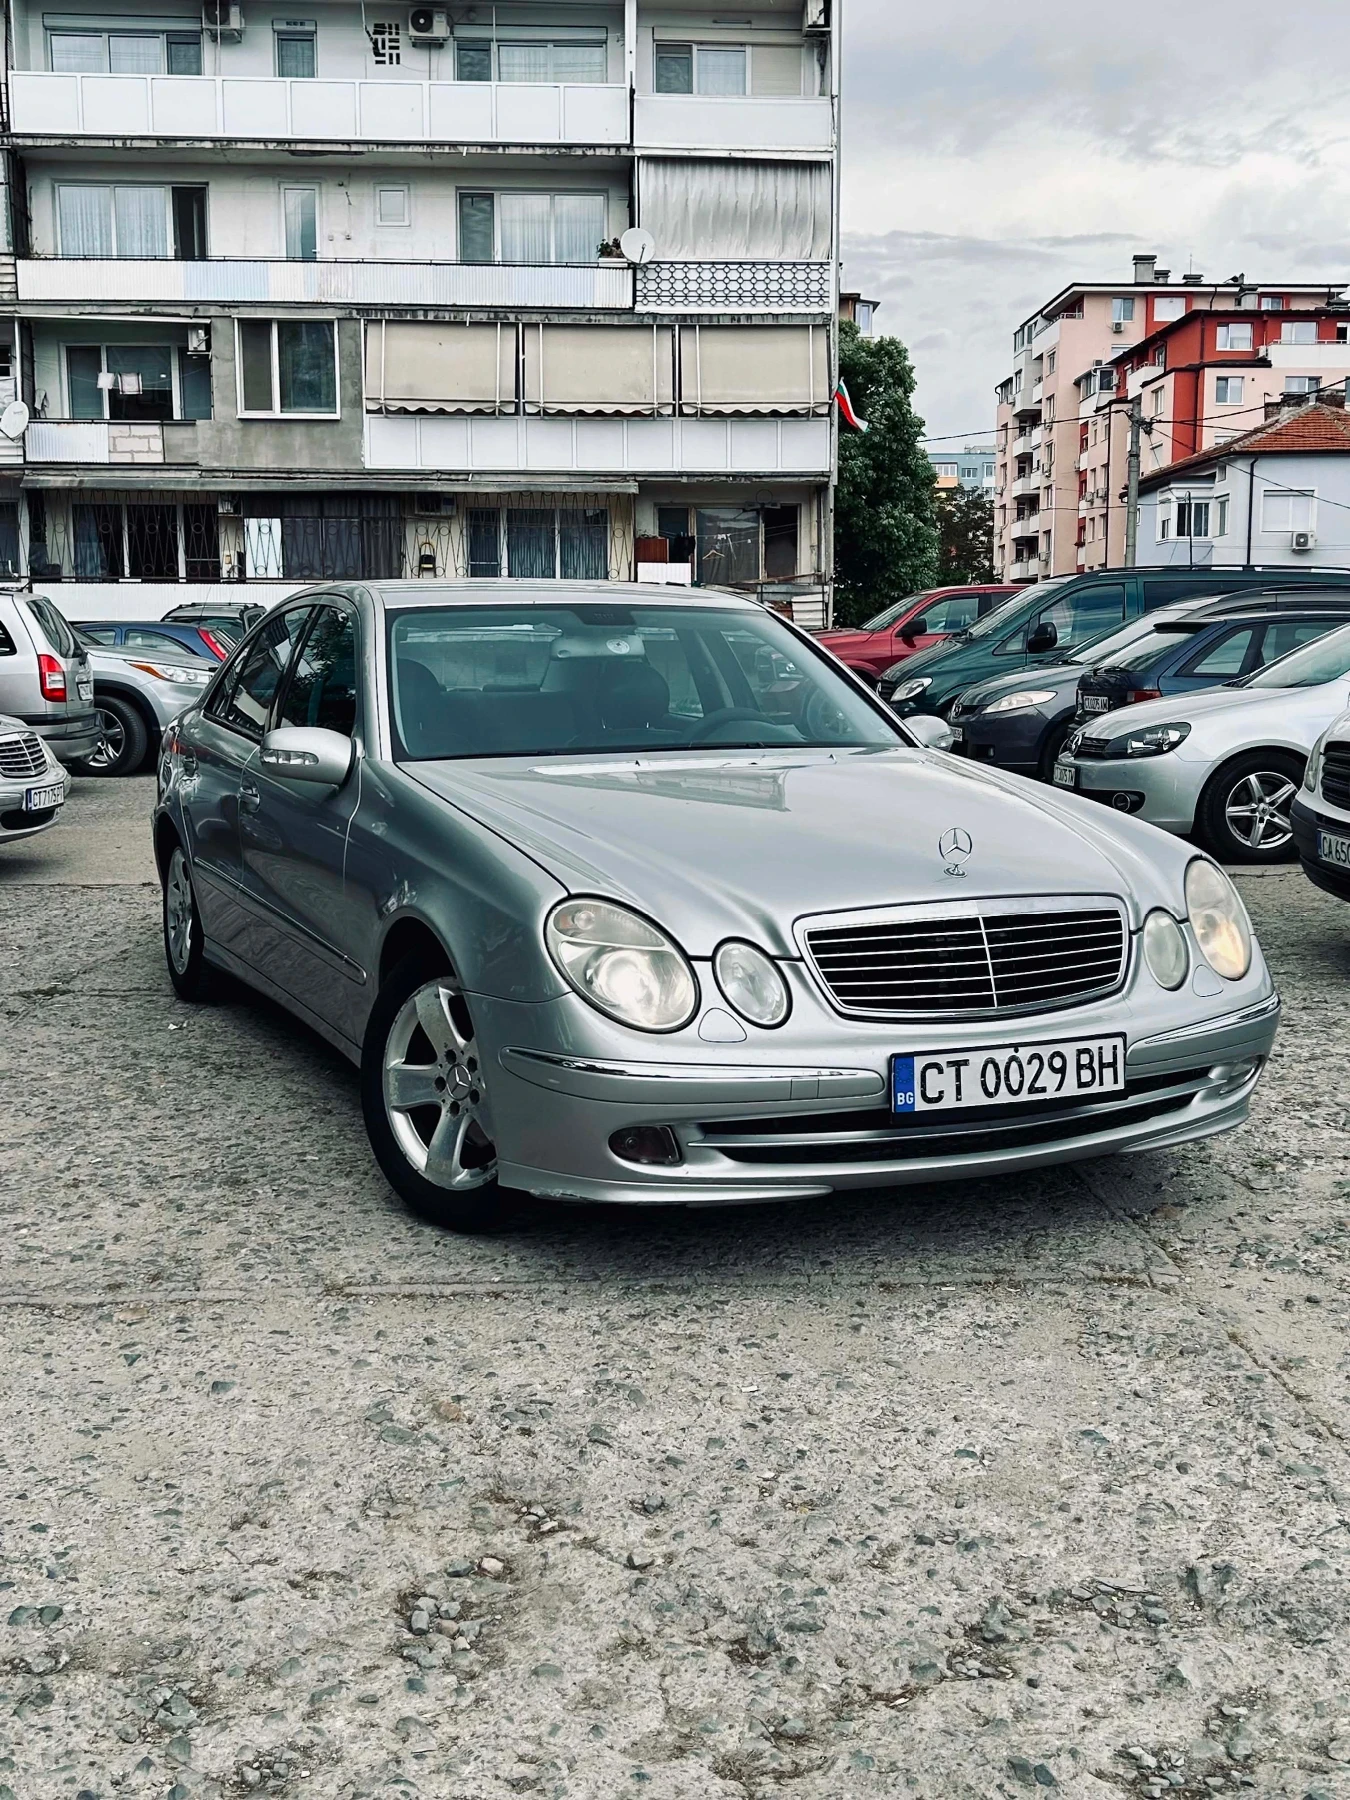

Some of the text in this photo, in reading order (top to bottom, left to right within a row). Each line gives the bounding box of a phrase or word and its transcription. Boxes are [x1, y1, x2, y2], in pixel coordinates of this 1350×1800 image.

[920, 1044, 1119, 1104] CT 0029 BH
[897, 1092, 914, 1106] BG
